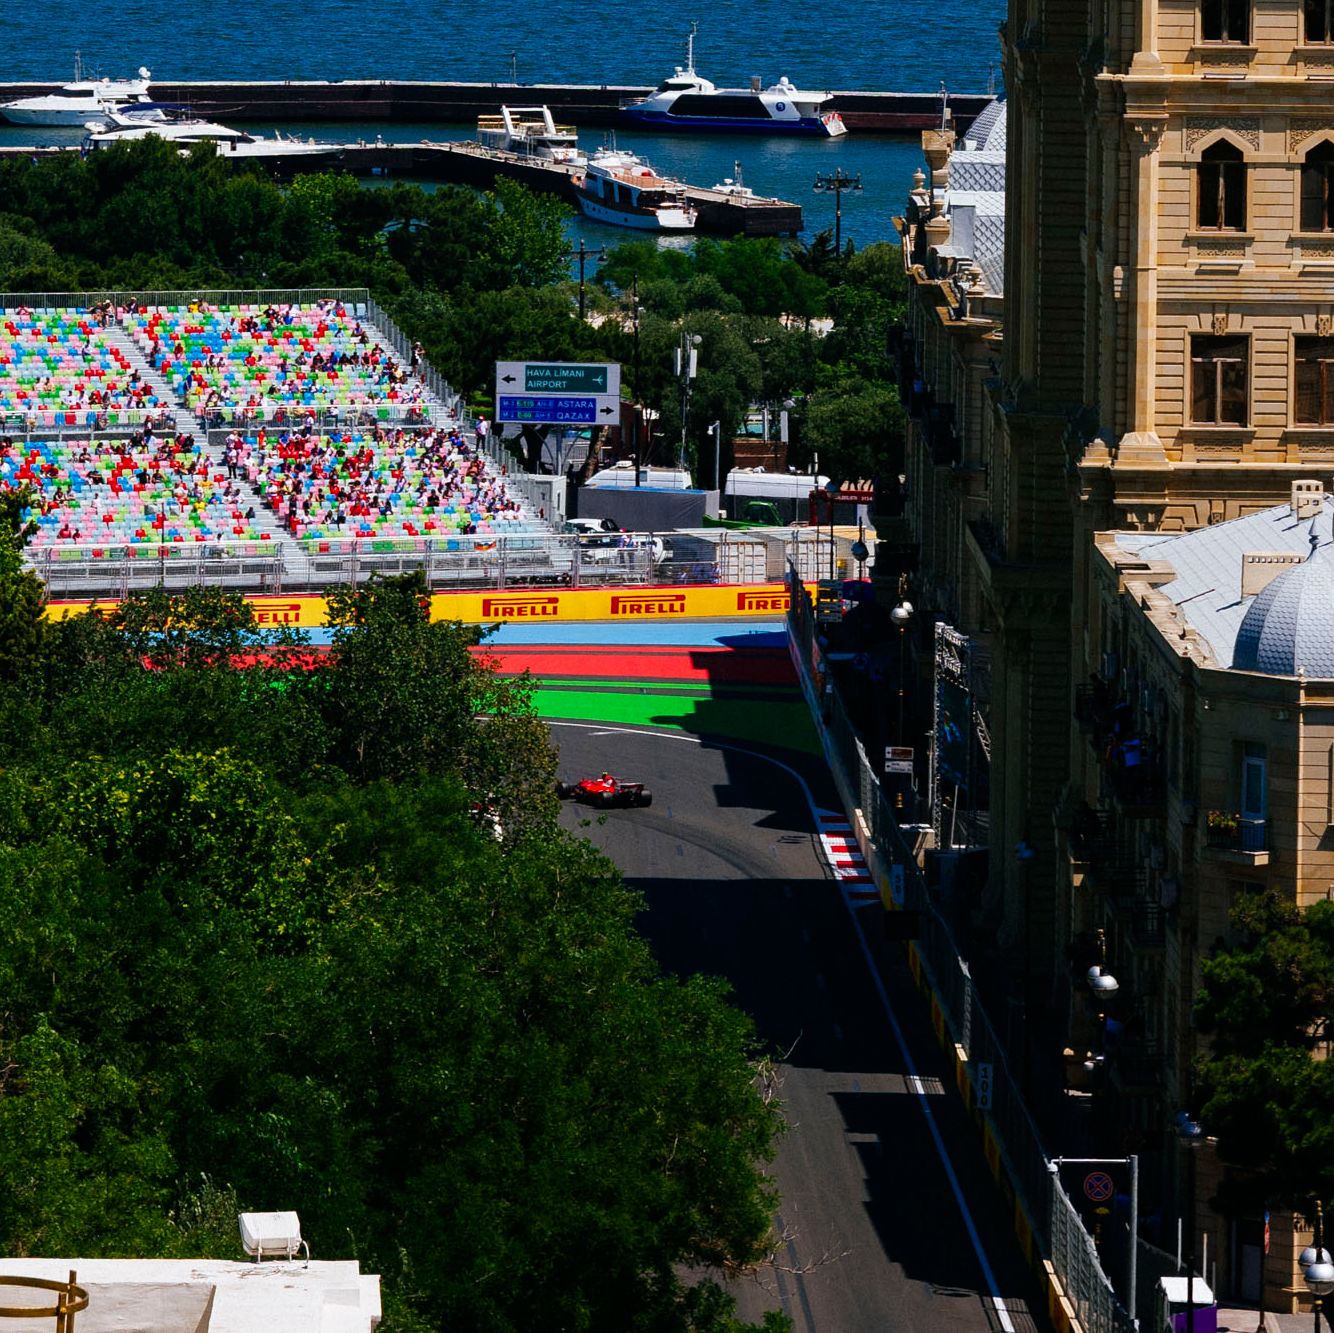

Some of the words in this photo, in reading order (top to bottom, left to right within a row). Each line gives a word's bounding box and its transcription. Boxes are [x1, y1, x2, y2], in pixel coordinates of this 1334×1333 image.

[526, 369, 552, 377] HAVA
[526, 380, 568, 389] AIRPORT
[557, 400, 594, 409] ASTARA
[556, 412, 590, 420] QAZAX
[482, 597, 559, 617] PIRELLI
[611, 594, 686, 615] PIRELLI
[981, 1066, 989, 1107] 100
